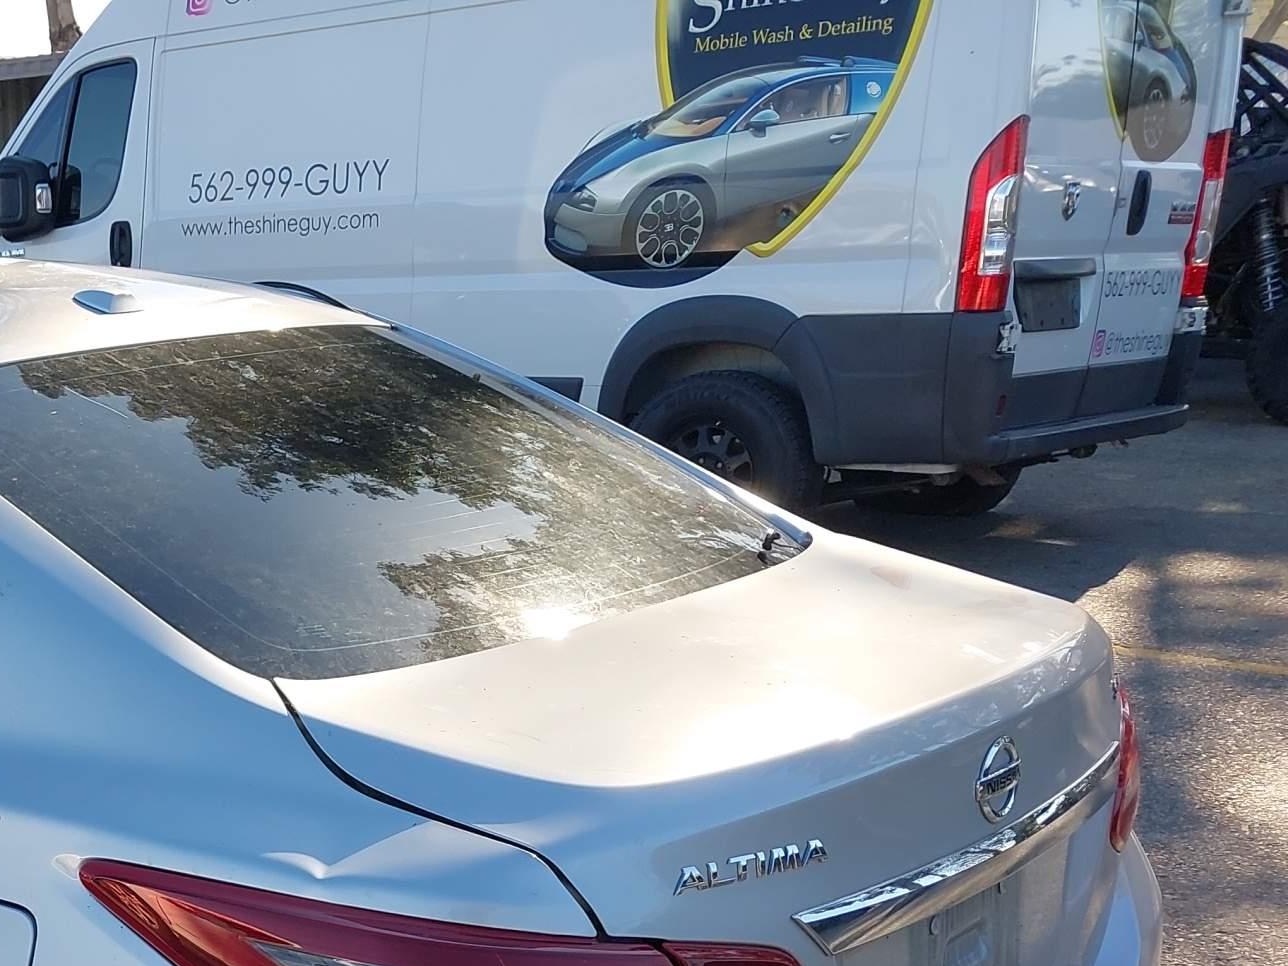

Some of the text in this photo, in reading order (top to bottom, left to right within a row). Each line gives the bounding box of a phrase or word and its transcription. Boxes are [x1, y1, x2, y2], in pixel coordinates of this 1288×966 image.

[694, 15, 894, 53] Mobile Wash & Detailing
[188, 158, 390, 204] 562-999-GUYY
[181, 210, 380, 238] www.theshineguy.com
[673, 838, 829, 897] ALTIMA
